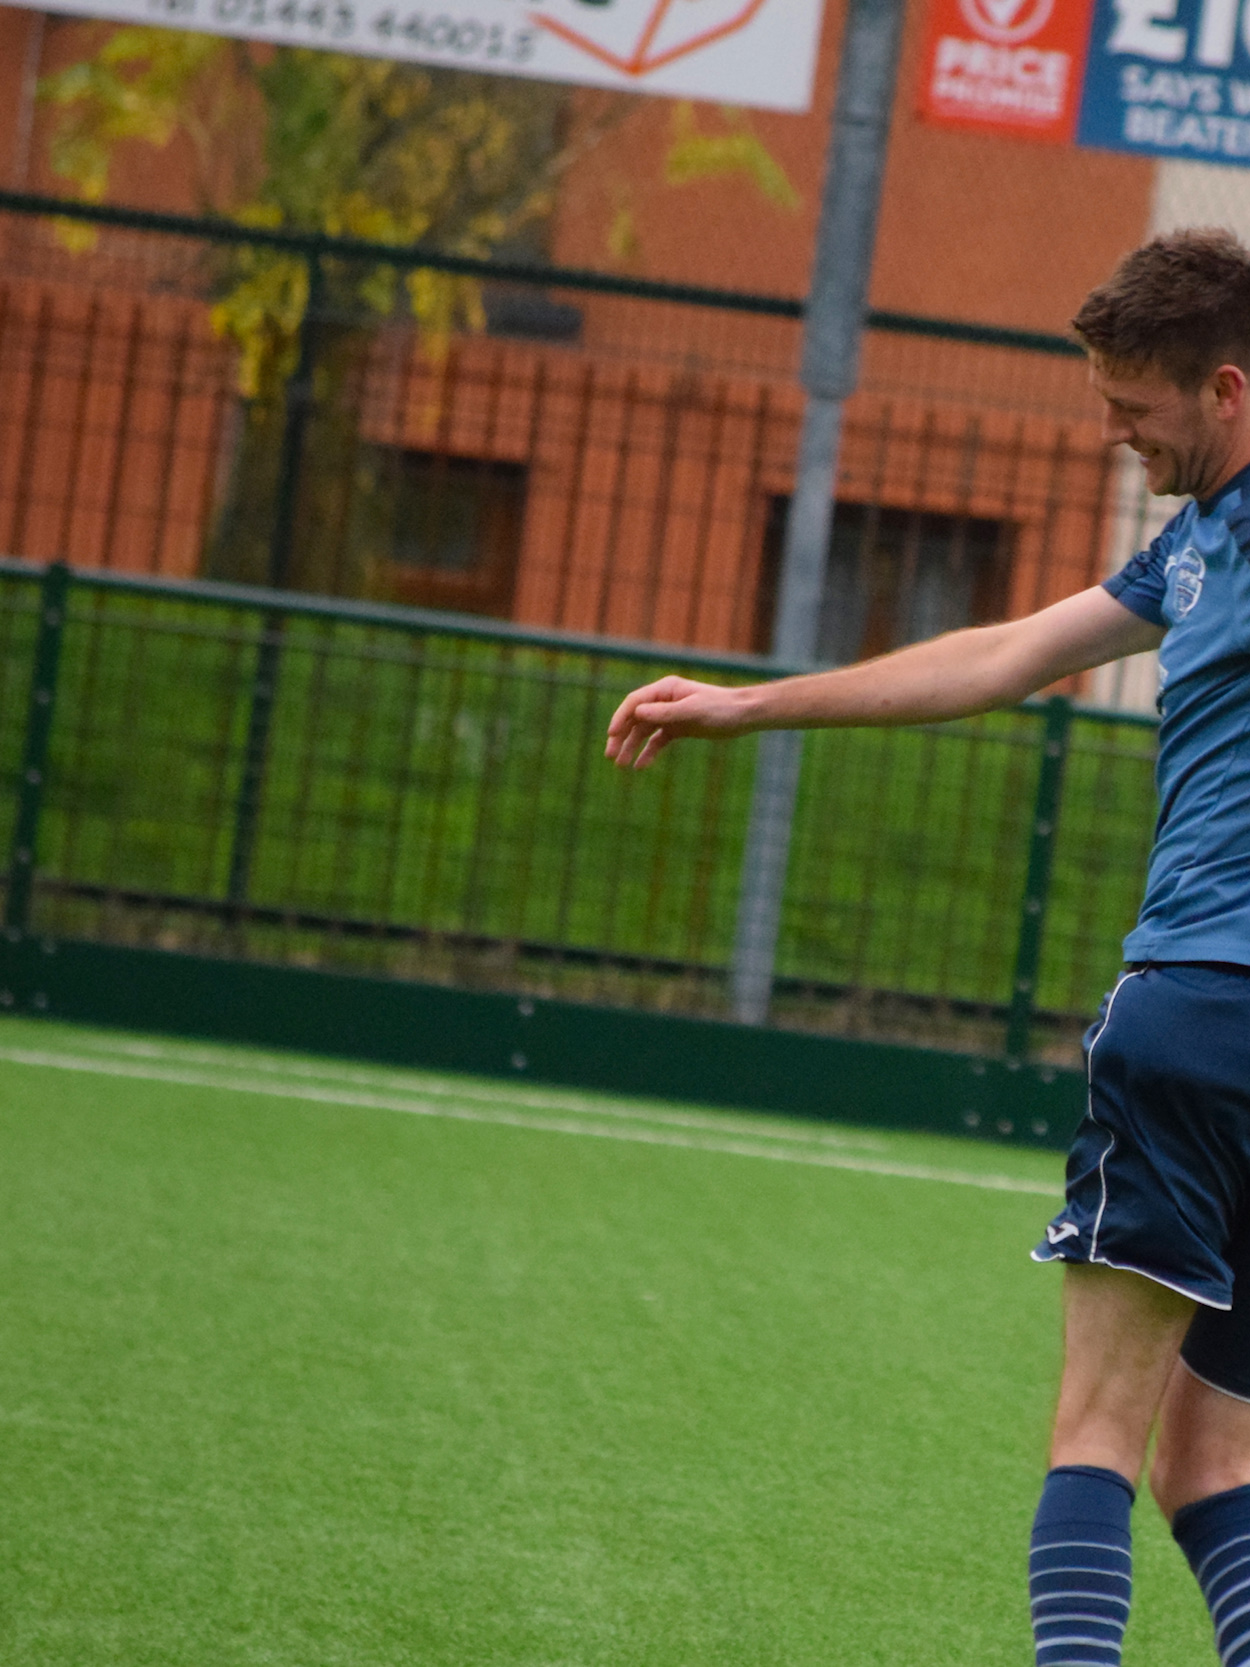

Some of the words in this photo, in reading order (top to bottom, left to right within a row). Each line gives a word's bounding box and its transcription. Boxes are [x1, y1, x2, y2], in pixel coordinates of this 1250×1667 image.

[214, 0, 352, 39] 01443
[934, 35, 1071, 88] PRICE
[1120, 63, 1221, 114] SAYS
